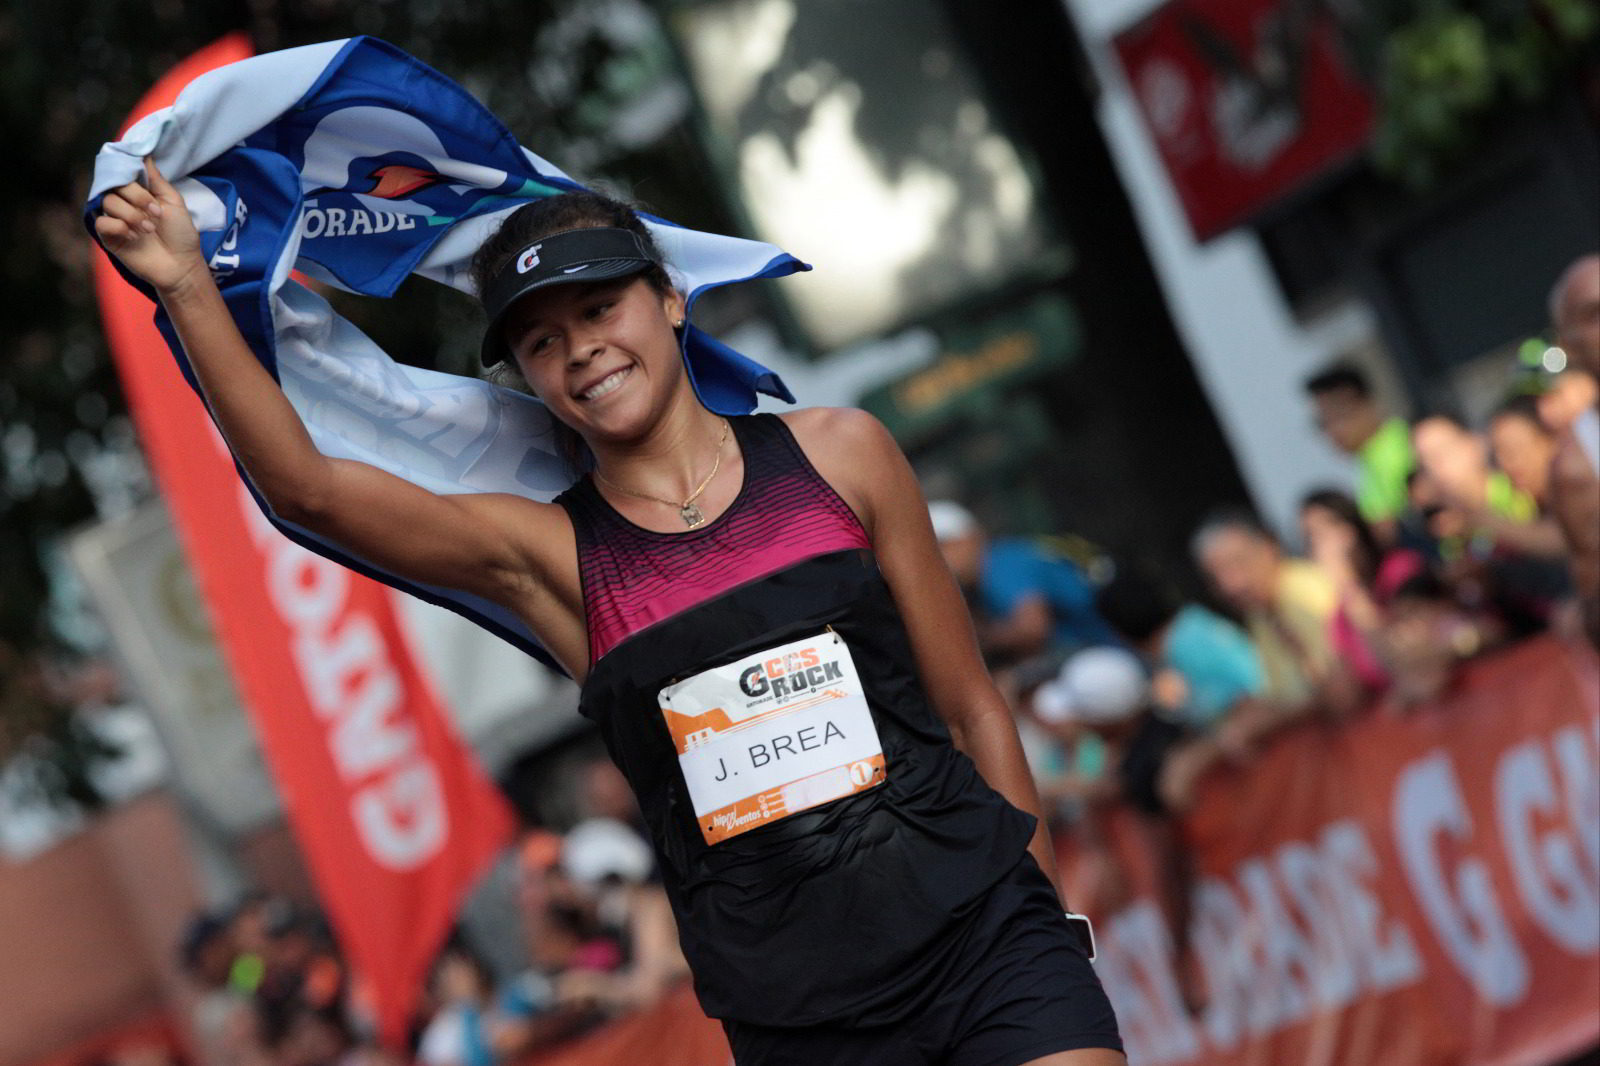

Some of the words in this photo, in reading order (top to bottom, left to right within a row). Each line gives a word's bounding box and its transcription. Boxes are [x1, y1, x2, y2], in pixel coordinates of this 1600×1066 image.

[301, 199, 416, 239] ORADE
[516, 243, 543, 275] G
[770, 660, 844, 699] ROCK
[715, 758, 738, 782] J.
[748, 720, 846, 769] BREA
